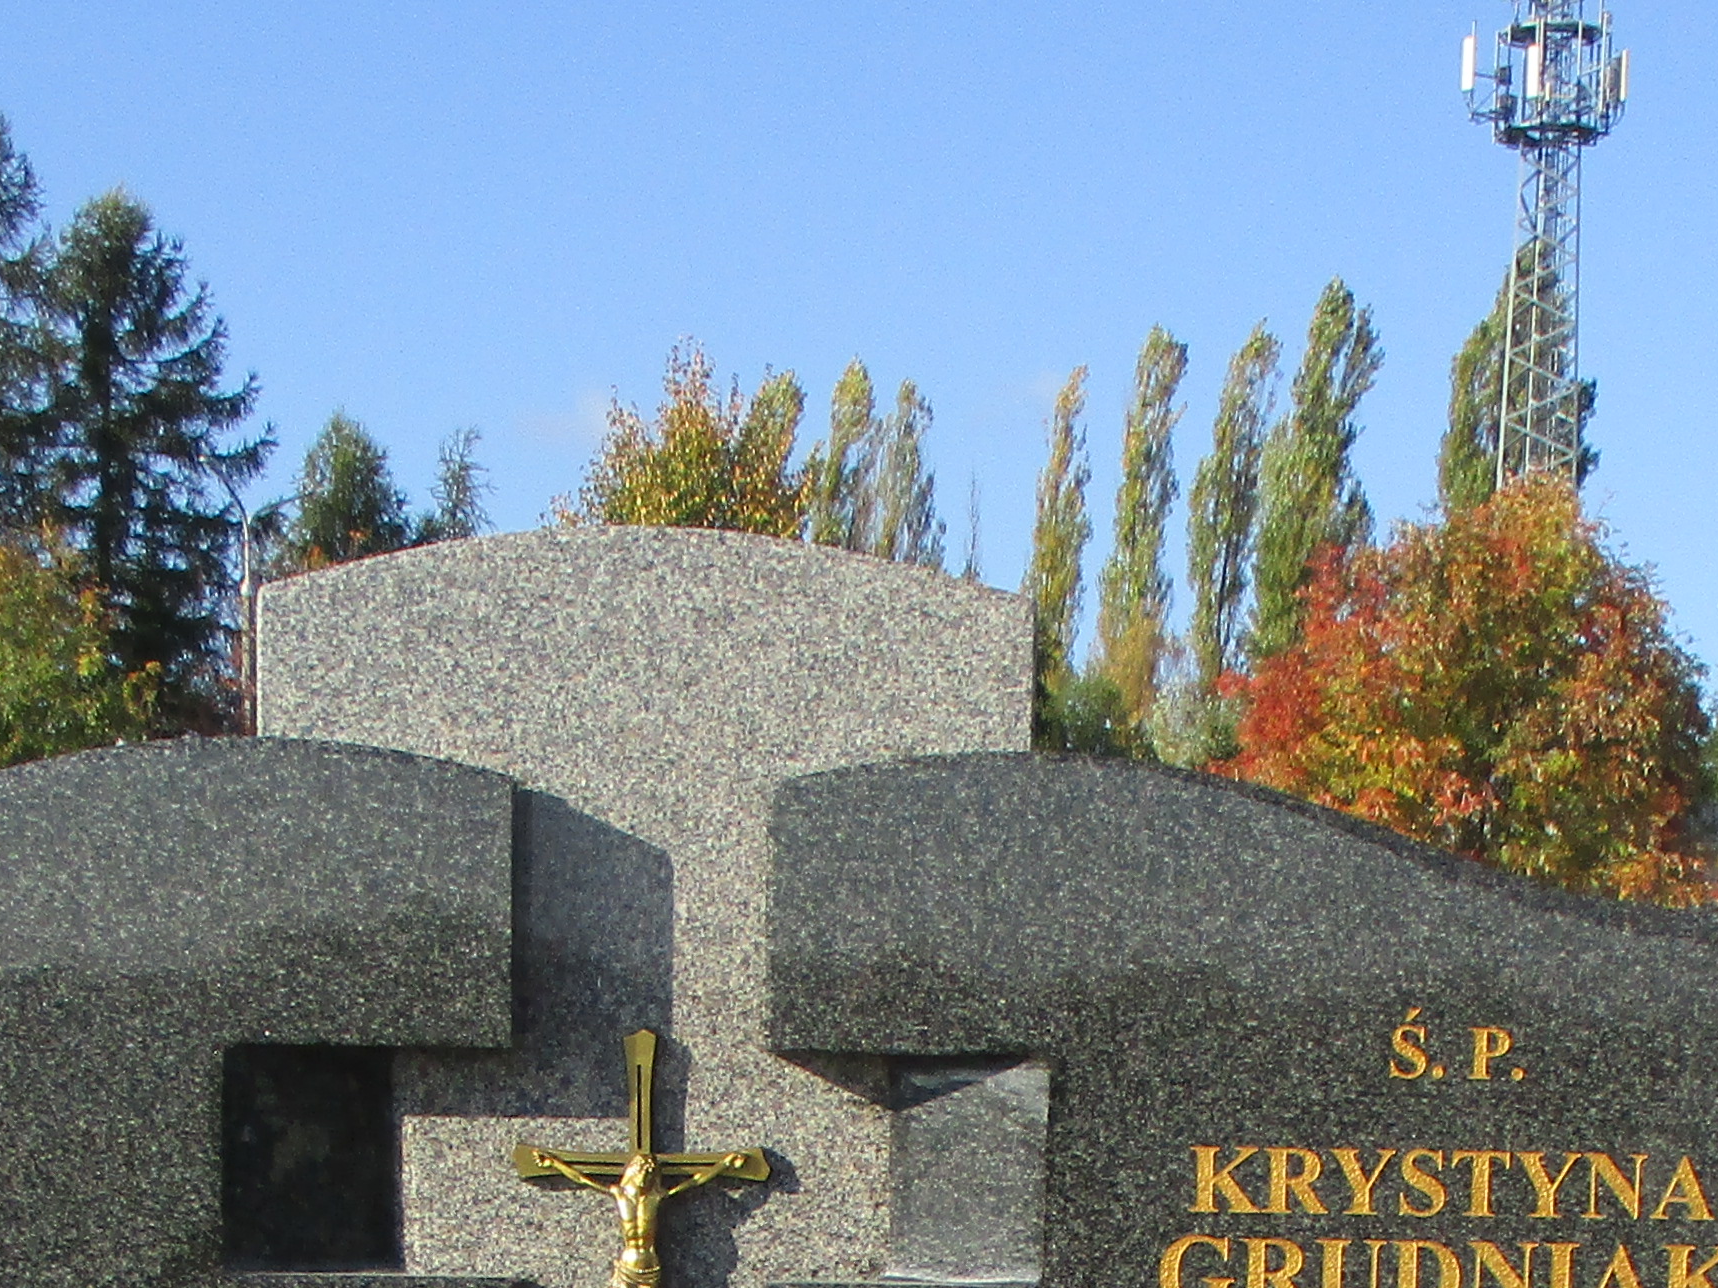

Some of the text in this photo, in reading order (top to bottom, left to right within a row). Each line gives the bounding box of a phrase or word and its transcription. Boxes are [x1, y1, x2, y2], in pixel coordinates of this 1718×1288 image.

[1389, 1008, 1527, 1081] Ś. P.
[1187, 1144, 1715, 1222] KRYSTYNA
